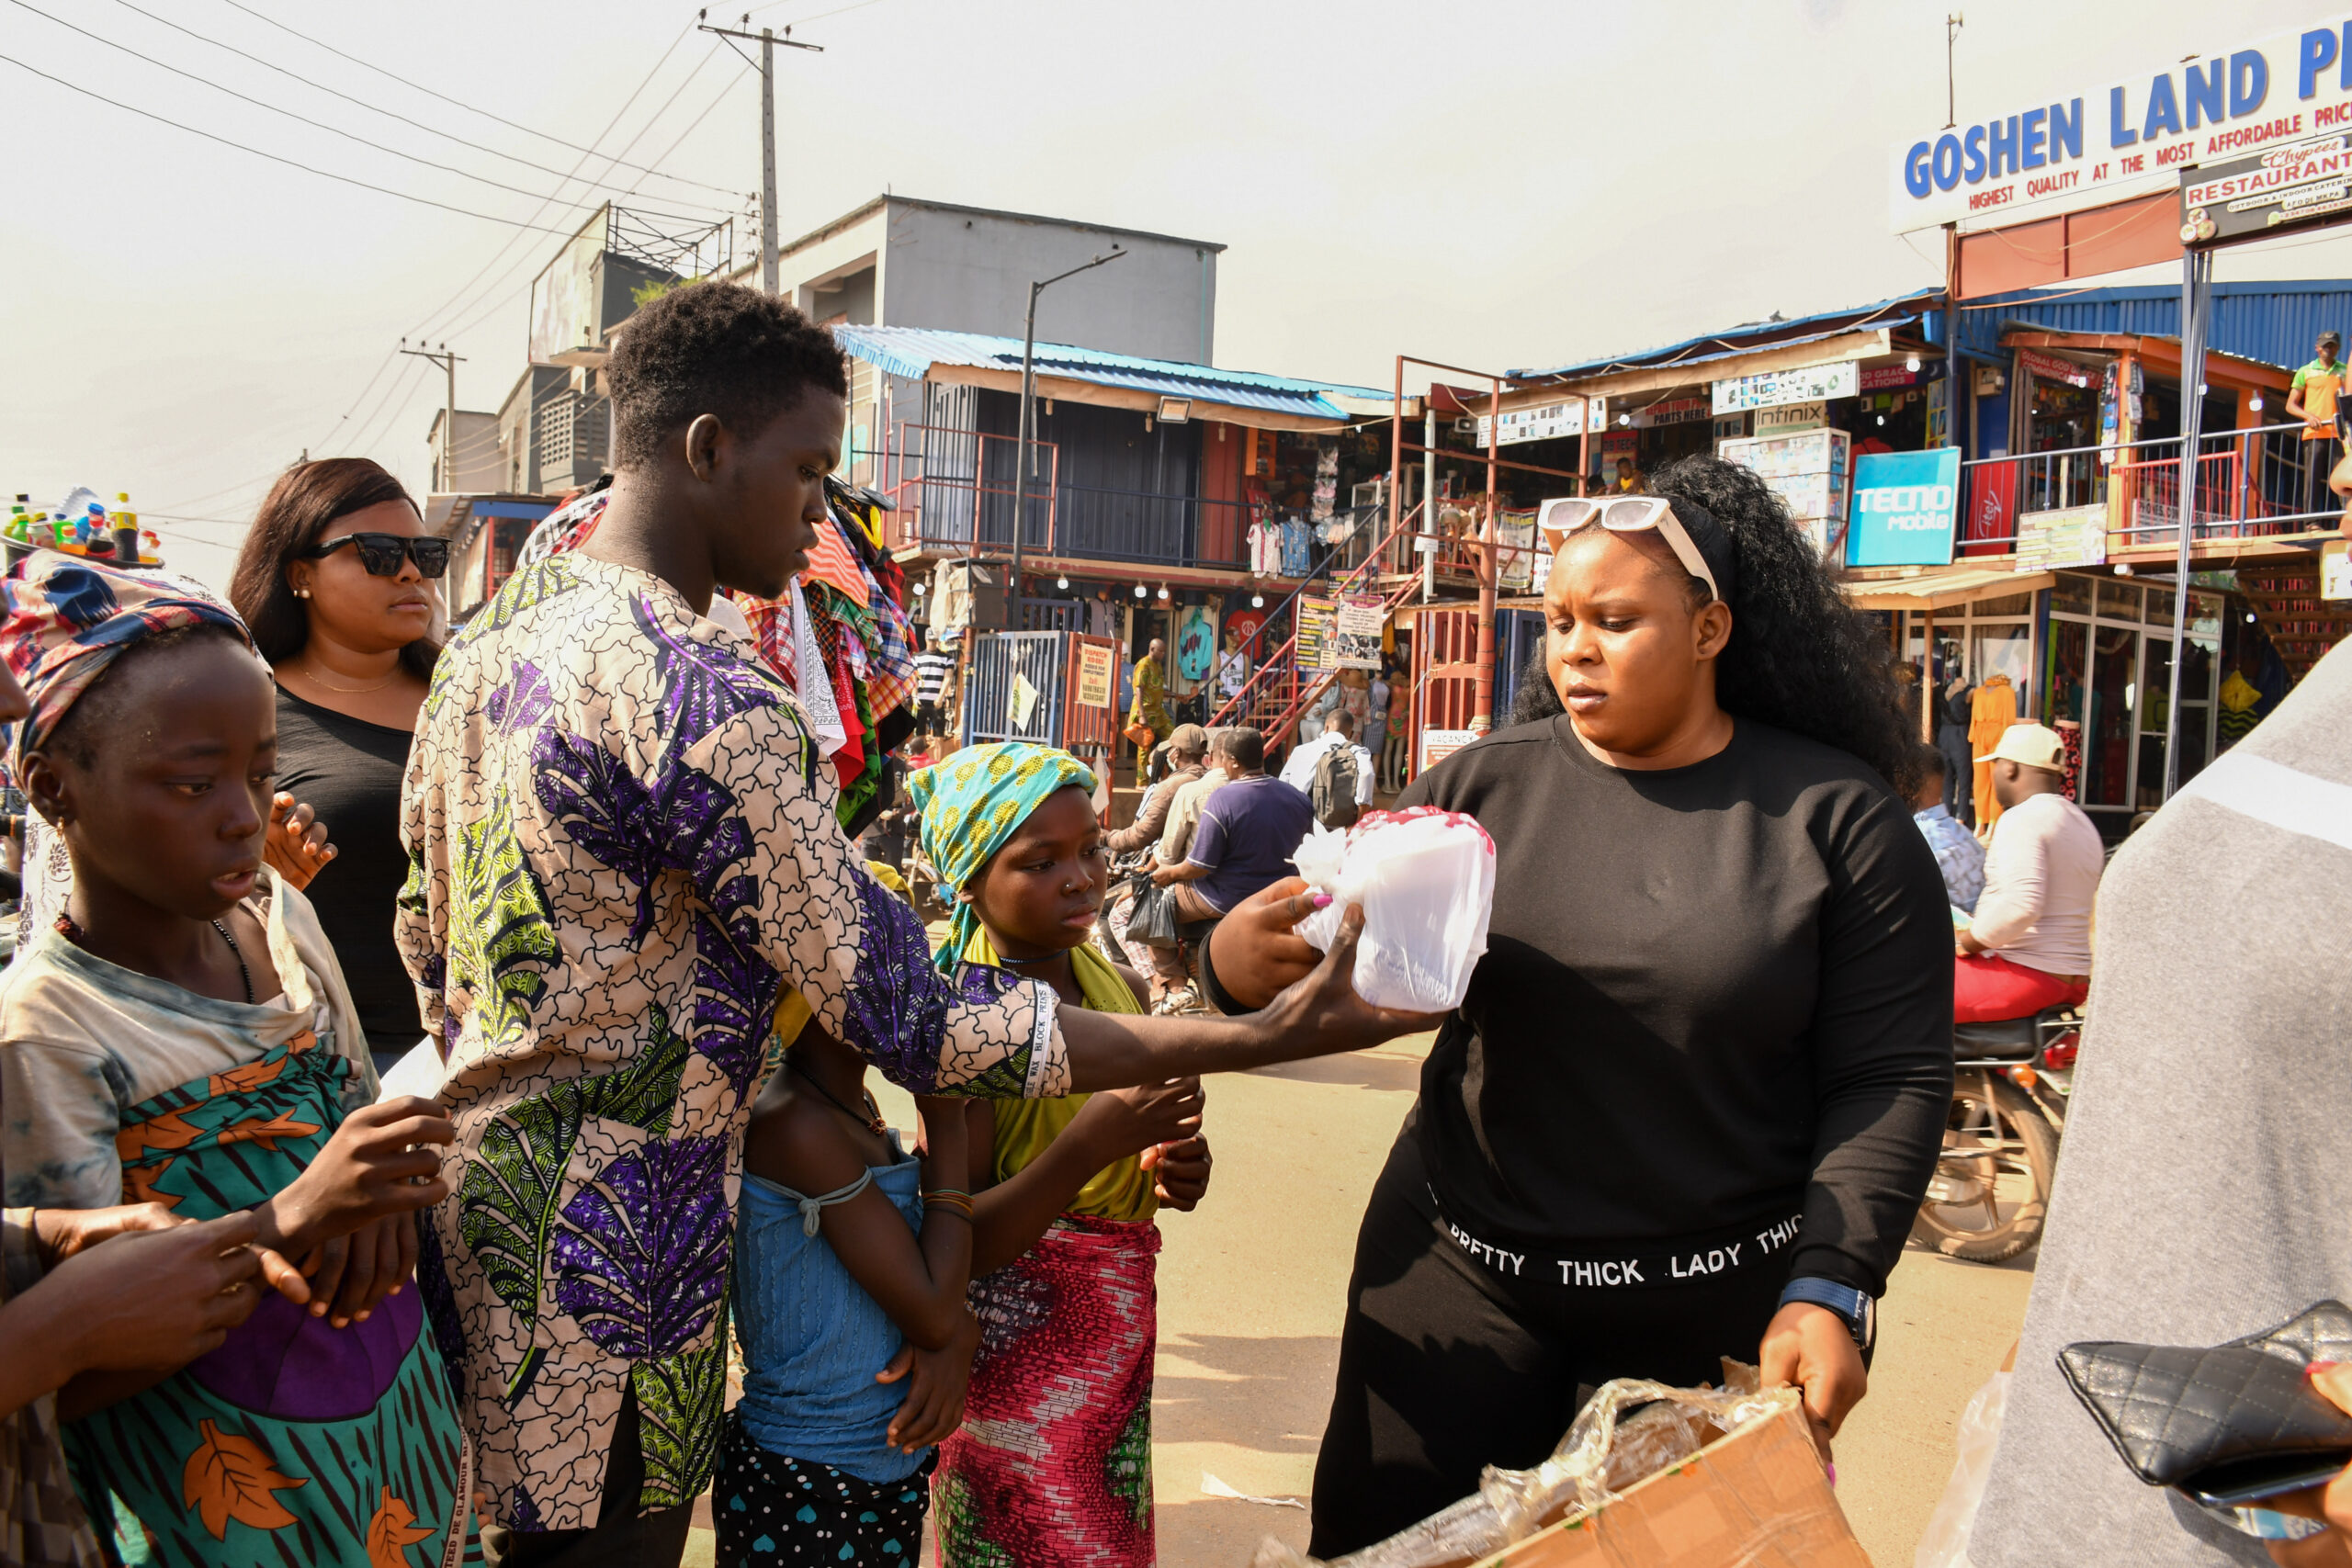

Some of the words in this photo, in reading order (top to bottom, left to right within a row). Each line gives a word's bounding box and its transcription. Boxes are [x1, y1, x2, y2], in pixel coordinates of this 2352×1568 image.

[1905, 97, 2083, 199] GOSHEN
[2110, 50, 2269, 149] LAND
[1969, 186, 2015, 210] HIGHEST
[2027, 170, 2080, 197] QUALITY
[2093, 163, 2109, 182] AT
[2121, 154, 2144, 175] THE
[2156, 141, 2195, 167] MOST
[2208, 115, 2302, 154] AFFORDABLE
[2315, 101, 2352, 128] PRIC
[2188, 152, 2352, 204] RESTAURANT
[2229, 193, 2269, 210] OUTDOOR
[2279, 186, 2313, 199] INDOOR
[2052, 360, 2070, 371] GOD
[1655, 411, 1682, 425] PARTS
[1684, 407, 1706, 420] HERE
[1756, 402, 1822, 426] Infinix
[1856, 485, 1952, 513] TECNO
[1231, 677, 1243, 687] 33
[1034, 1021, 1046, 1052] BLOCK
[1030, 1060, 1040, 1077] WAX
[1557, 1259, 1645, 1286] THICK
[1671, 1243, 1741, 1278] LADY
[456, 1462, 468, 1517] GLAMOUR
[452, 1520, 461, 1535] DE
